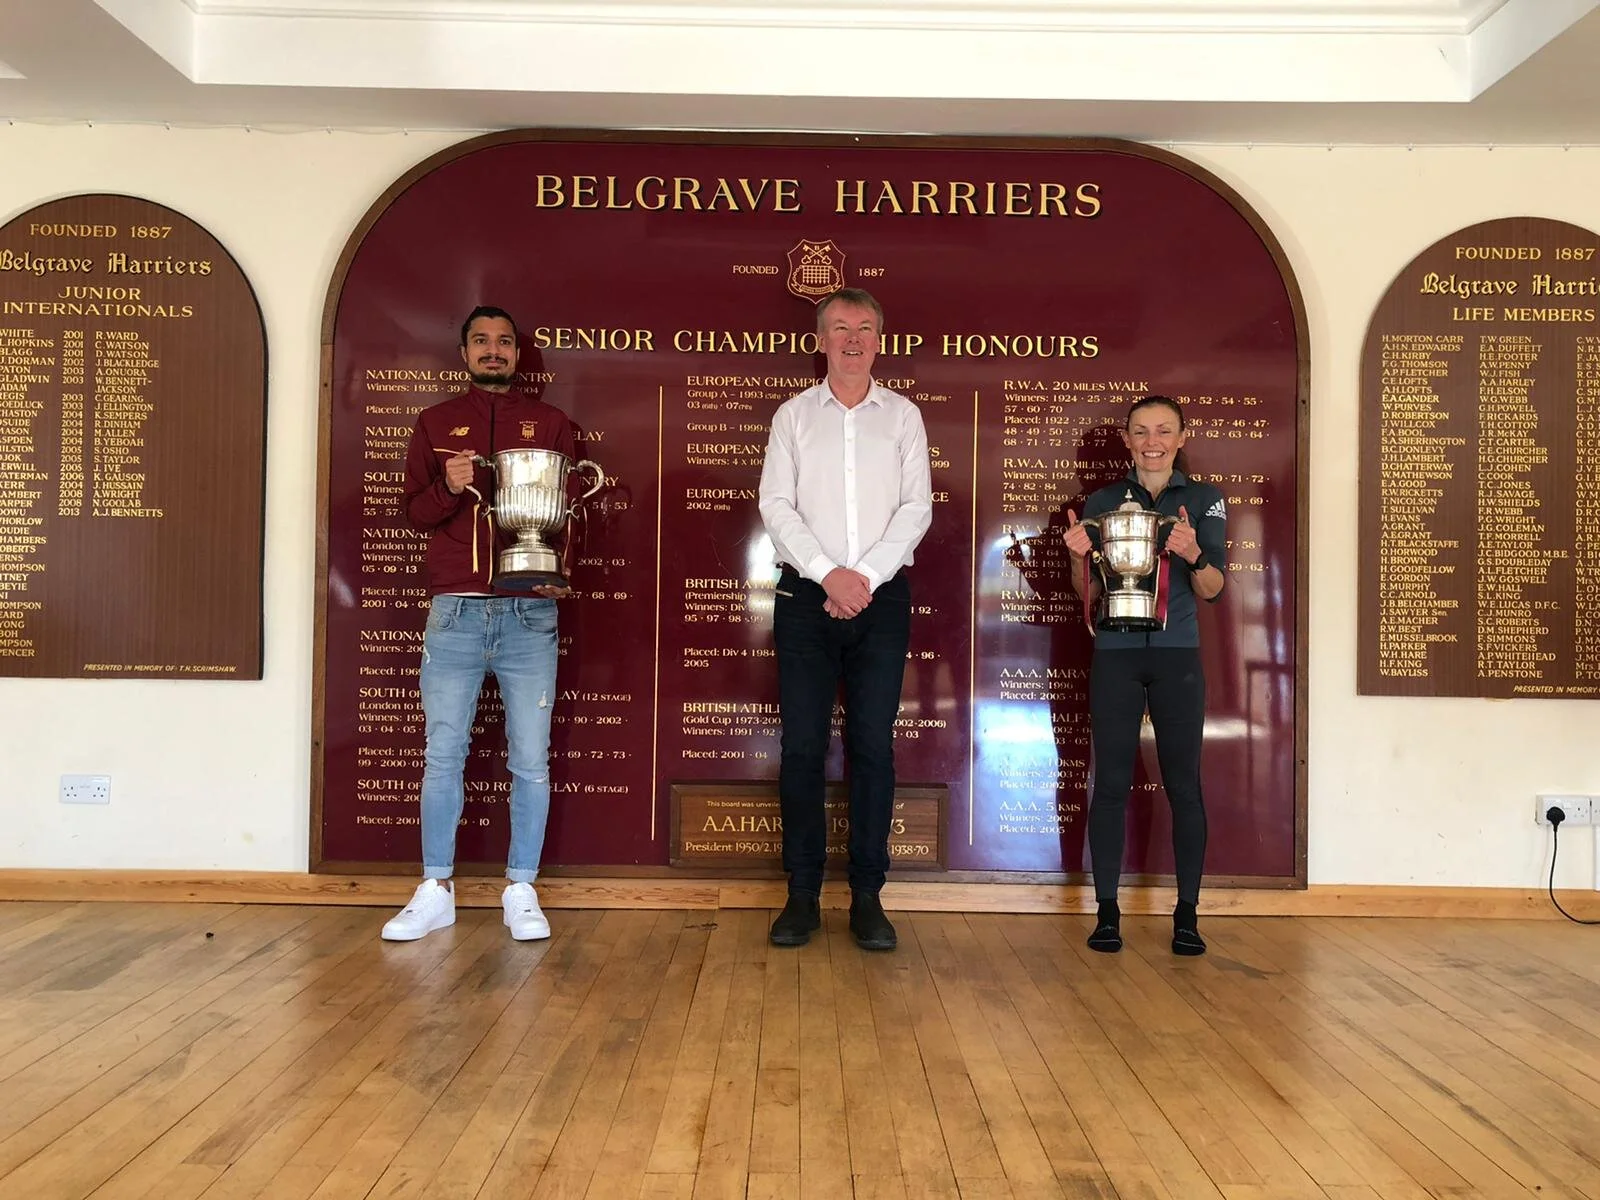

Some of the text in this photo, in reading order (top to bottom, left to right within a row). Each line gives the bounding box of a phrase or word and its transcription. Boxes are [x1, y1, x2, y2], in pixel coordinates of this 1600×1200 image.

[535, 174, 1101, 217] BELGRAVE HARRIERS
[30, 224, 172, 239] FOUNDED 1887
[1456, 247, 1595, 260] FOUNDED 1887
[0, 250, 212, 276] Belgrave Harriers
[732, 265, 884, 276] FOUNDED 1887
[1420, 272, 1600, 298] Belgrave Harri
[58, 286, 141, 300] JUNIOR
[3, 302, 193, 317] INTERNATIONALS
[1453, 308, 1595, 321] LIFE MEMBERS
[63, 331, 84, 339] 2001
[534, 327, 654, 350] SENIOR
[942, 334, 1099, 358] HONOURS
[366, 370, 473, 381] NATIONAL CRO
[366, 383, 410, 392] Winners:
[687, 376, 915, 389] EUROPEAN CUP
[1004, 380, 1149, 392] R.W.A. 20 MILES WALK
[95, 386, 136, 394] JACKSON
[688, 390, 718, 399] Group
[739, 391, 763, 399] 1993
[1004, 393, 1048, 402] Winners:
[1177, 396, 1190, 404] 39
[366, 405, 401, 414] Placed:
[1004, 416, 1041, 424] Placed:
[687, 444, 761, 454] EUROPEAN
[1004, 458, 1069, 468] R.W.A. 10
[686, 489, 755, 499] EUROPEAN
[578, 558, 603, 566] 2002
[384, 565, 396, 573] 09
[685, 579, 738, 589] BRITISH
[361, 587, 397, 596] Placed:
[684, 648, 719, 657] Placed:
[684, 660, 709, 668] 2005
[1000, 668, 1042, 678] A.A.A.
[359, 687, 405, 698] SOUTH
[359, 702, 400, 711] (London
[683, 703, 737, 713] BRITISH
[574, 716, 622, 724] 90 2002
[683, 716, 731, 726] (Gold Cup
[682, 727, 725, 736] Winners:
[682, 750, 718, 759] Placed:
[1058, 803, 1081, 812] KMS
[685, 842, 732, 852] President
